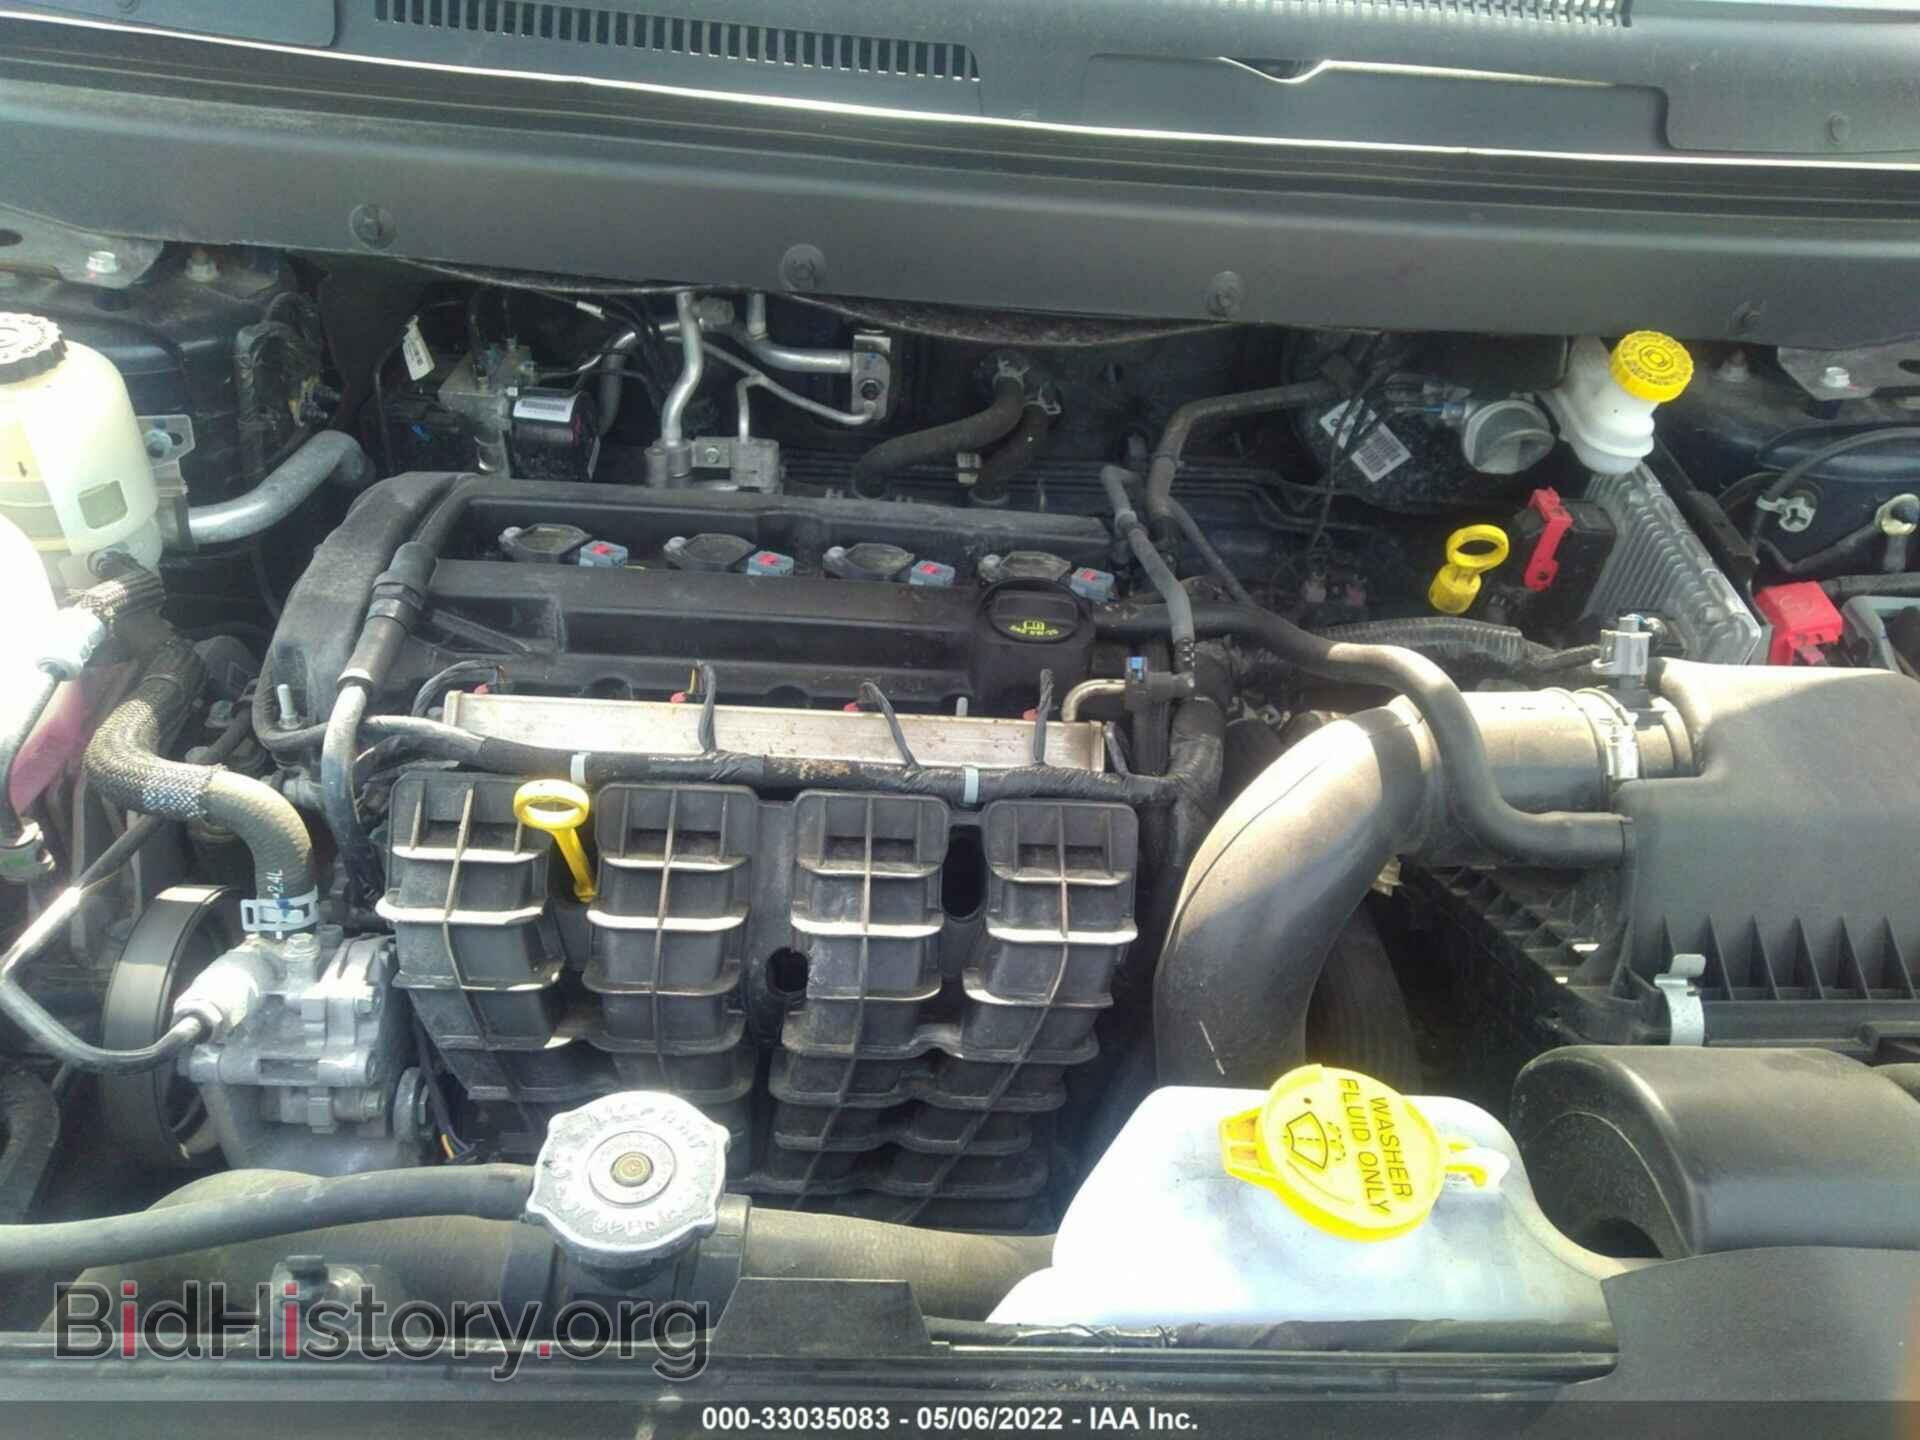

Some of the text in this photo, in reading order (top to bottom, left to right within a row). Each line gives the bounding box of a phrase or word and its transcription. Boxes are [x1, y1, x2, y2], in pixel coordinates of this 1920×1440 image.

[1339, 1078, 1392, 1214] FLUID ONLY
[1369, 1096, 1413, 1198] WASHER
